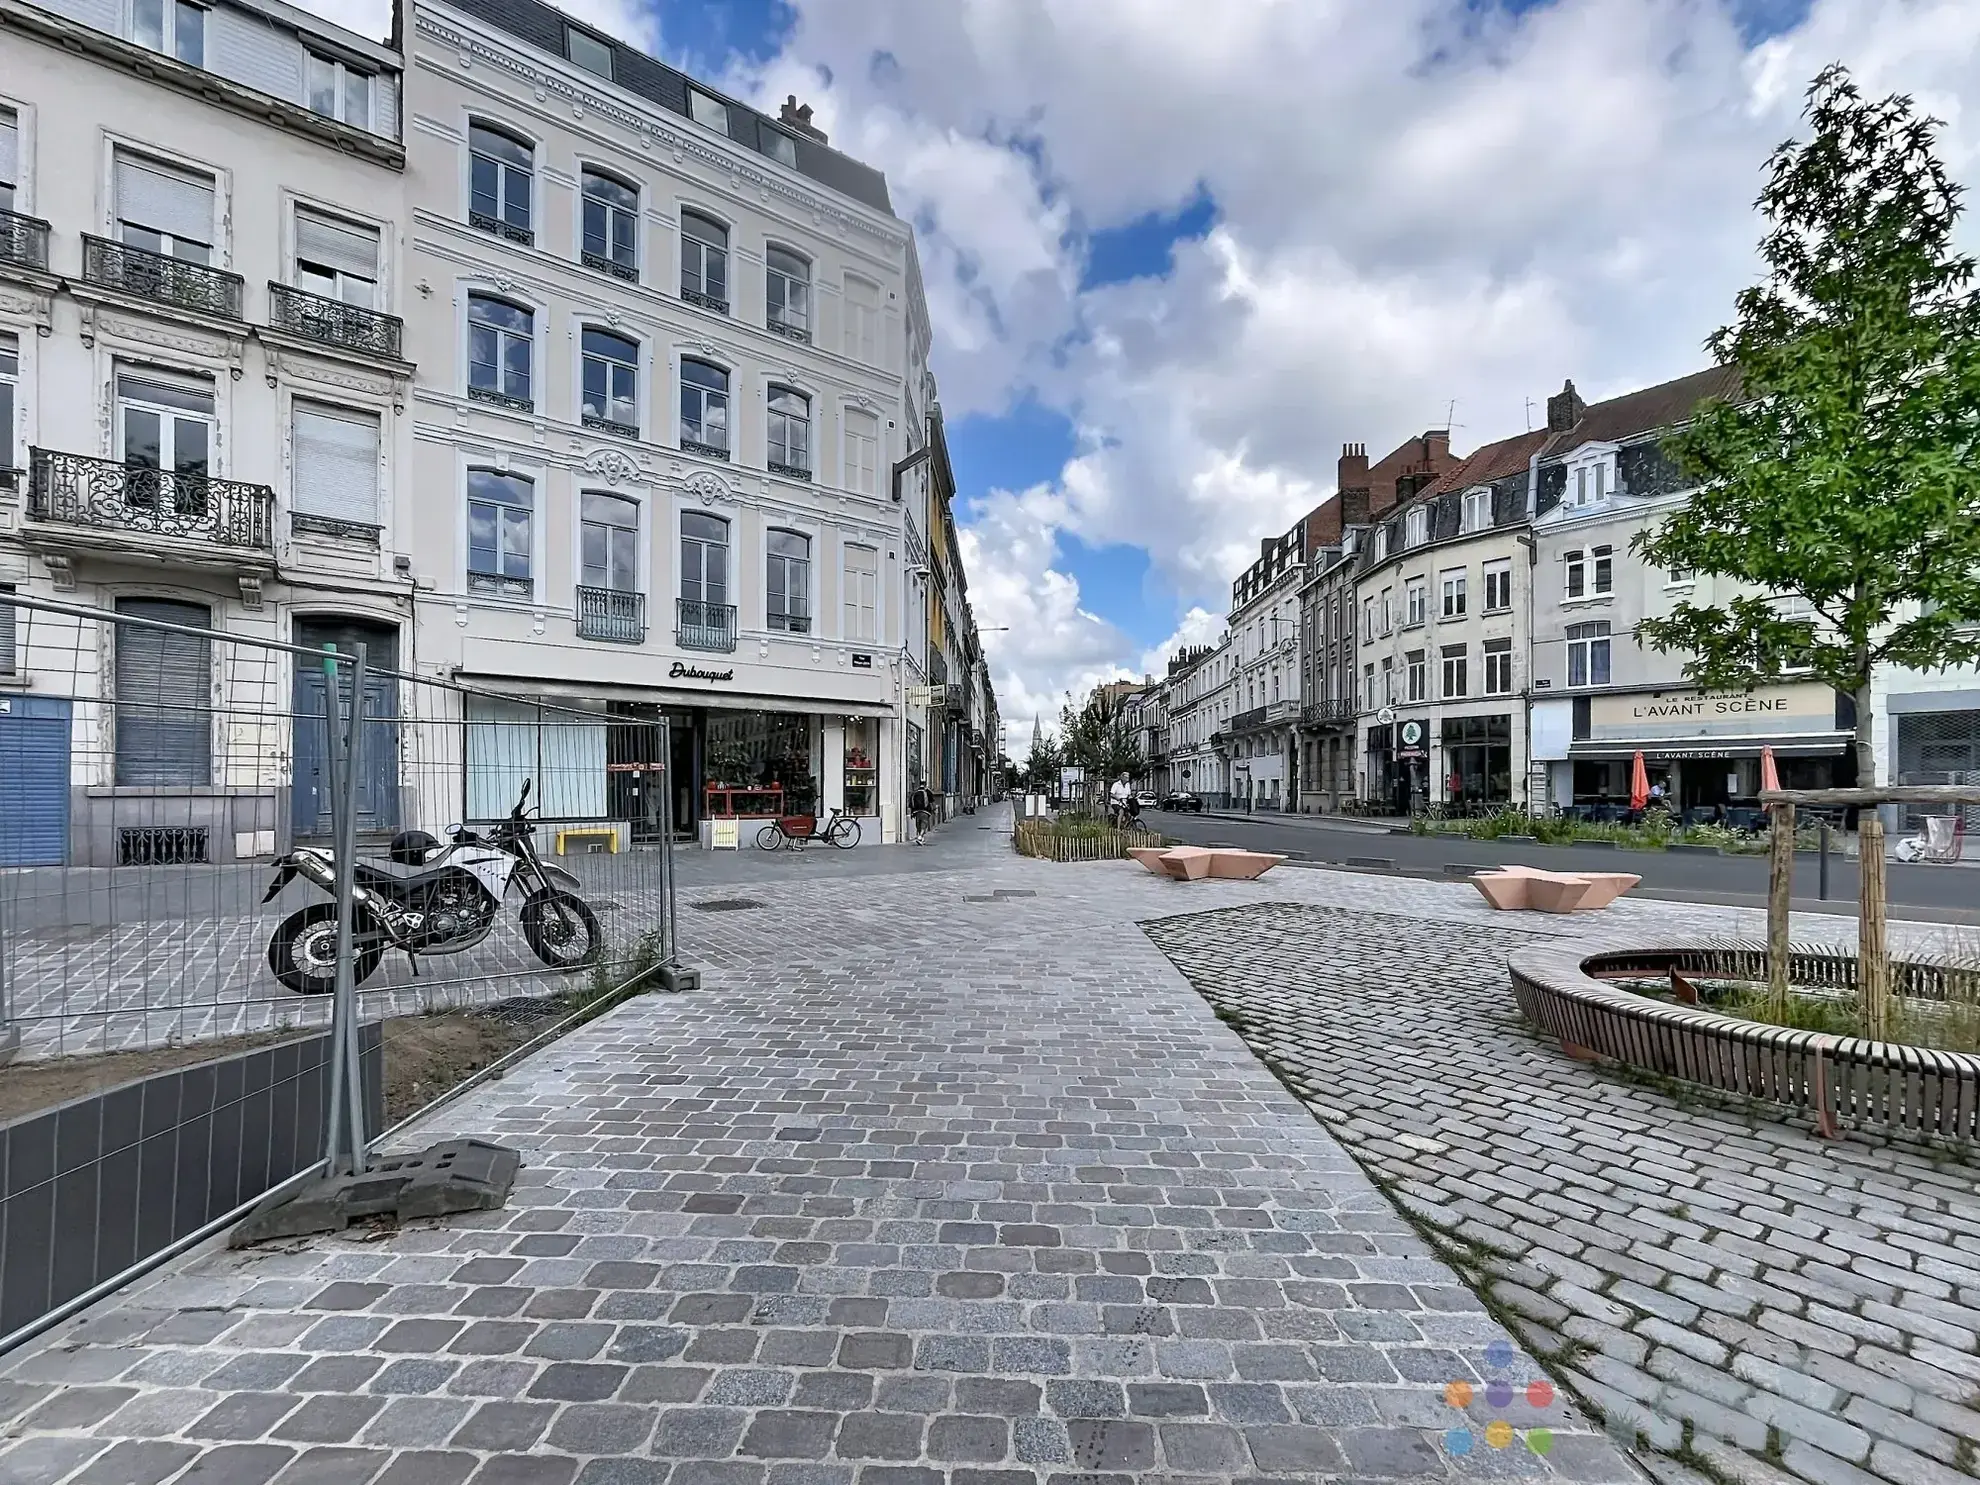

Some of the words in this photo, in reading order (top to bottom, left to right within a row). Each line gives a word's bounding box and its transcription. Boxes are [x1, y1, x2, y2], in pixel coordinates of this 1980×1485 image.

[668, 661, 734, 684] Dubouquet
[1684, 693, 1748, 702] RESTAURANT
[1633, 704, 1705, 718] L'AVANT
[1715, 698, 1788, 714] SCÈNE
[1698, 751, 1731, 759] SCÈNE
